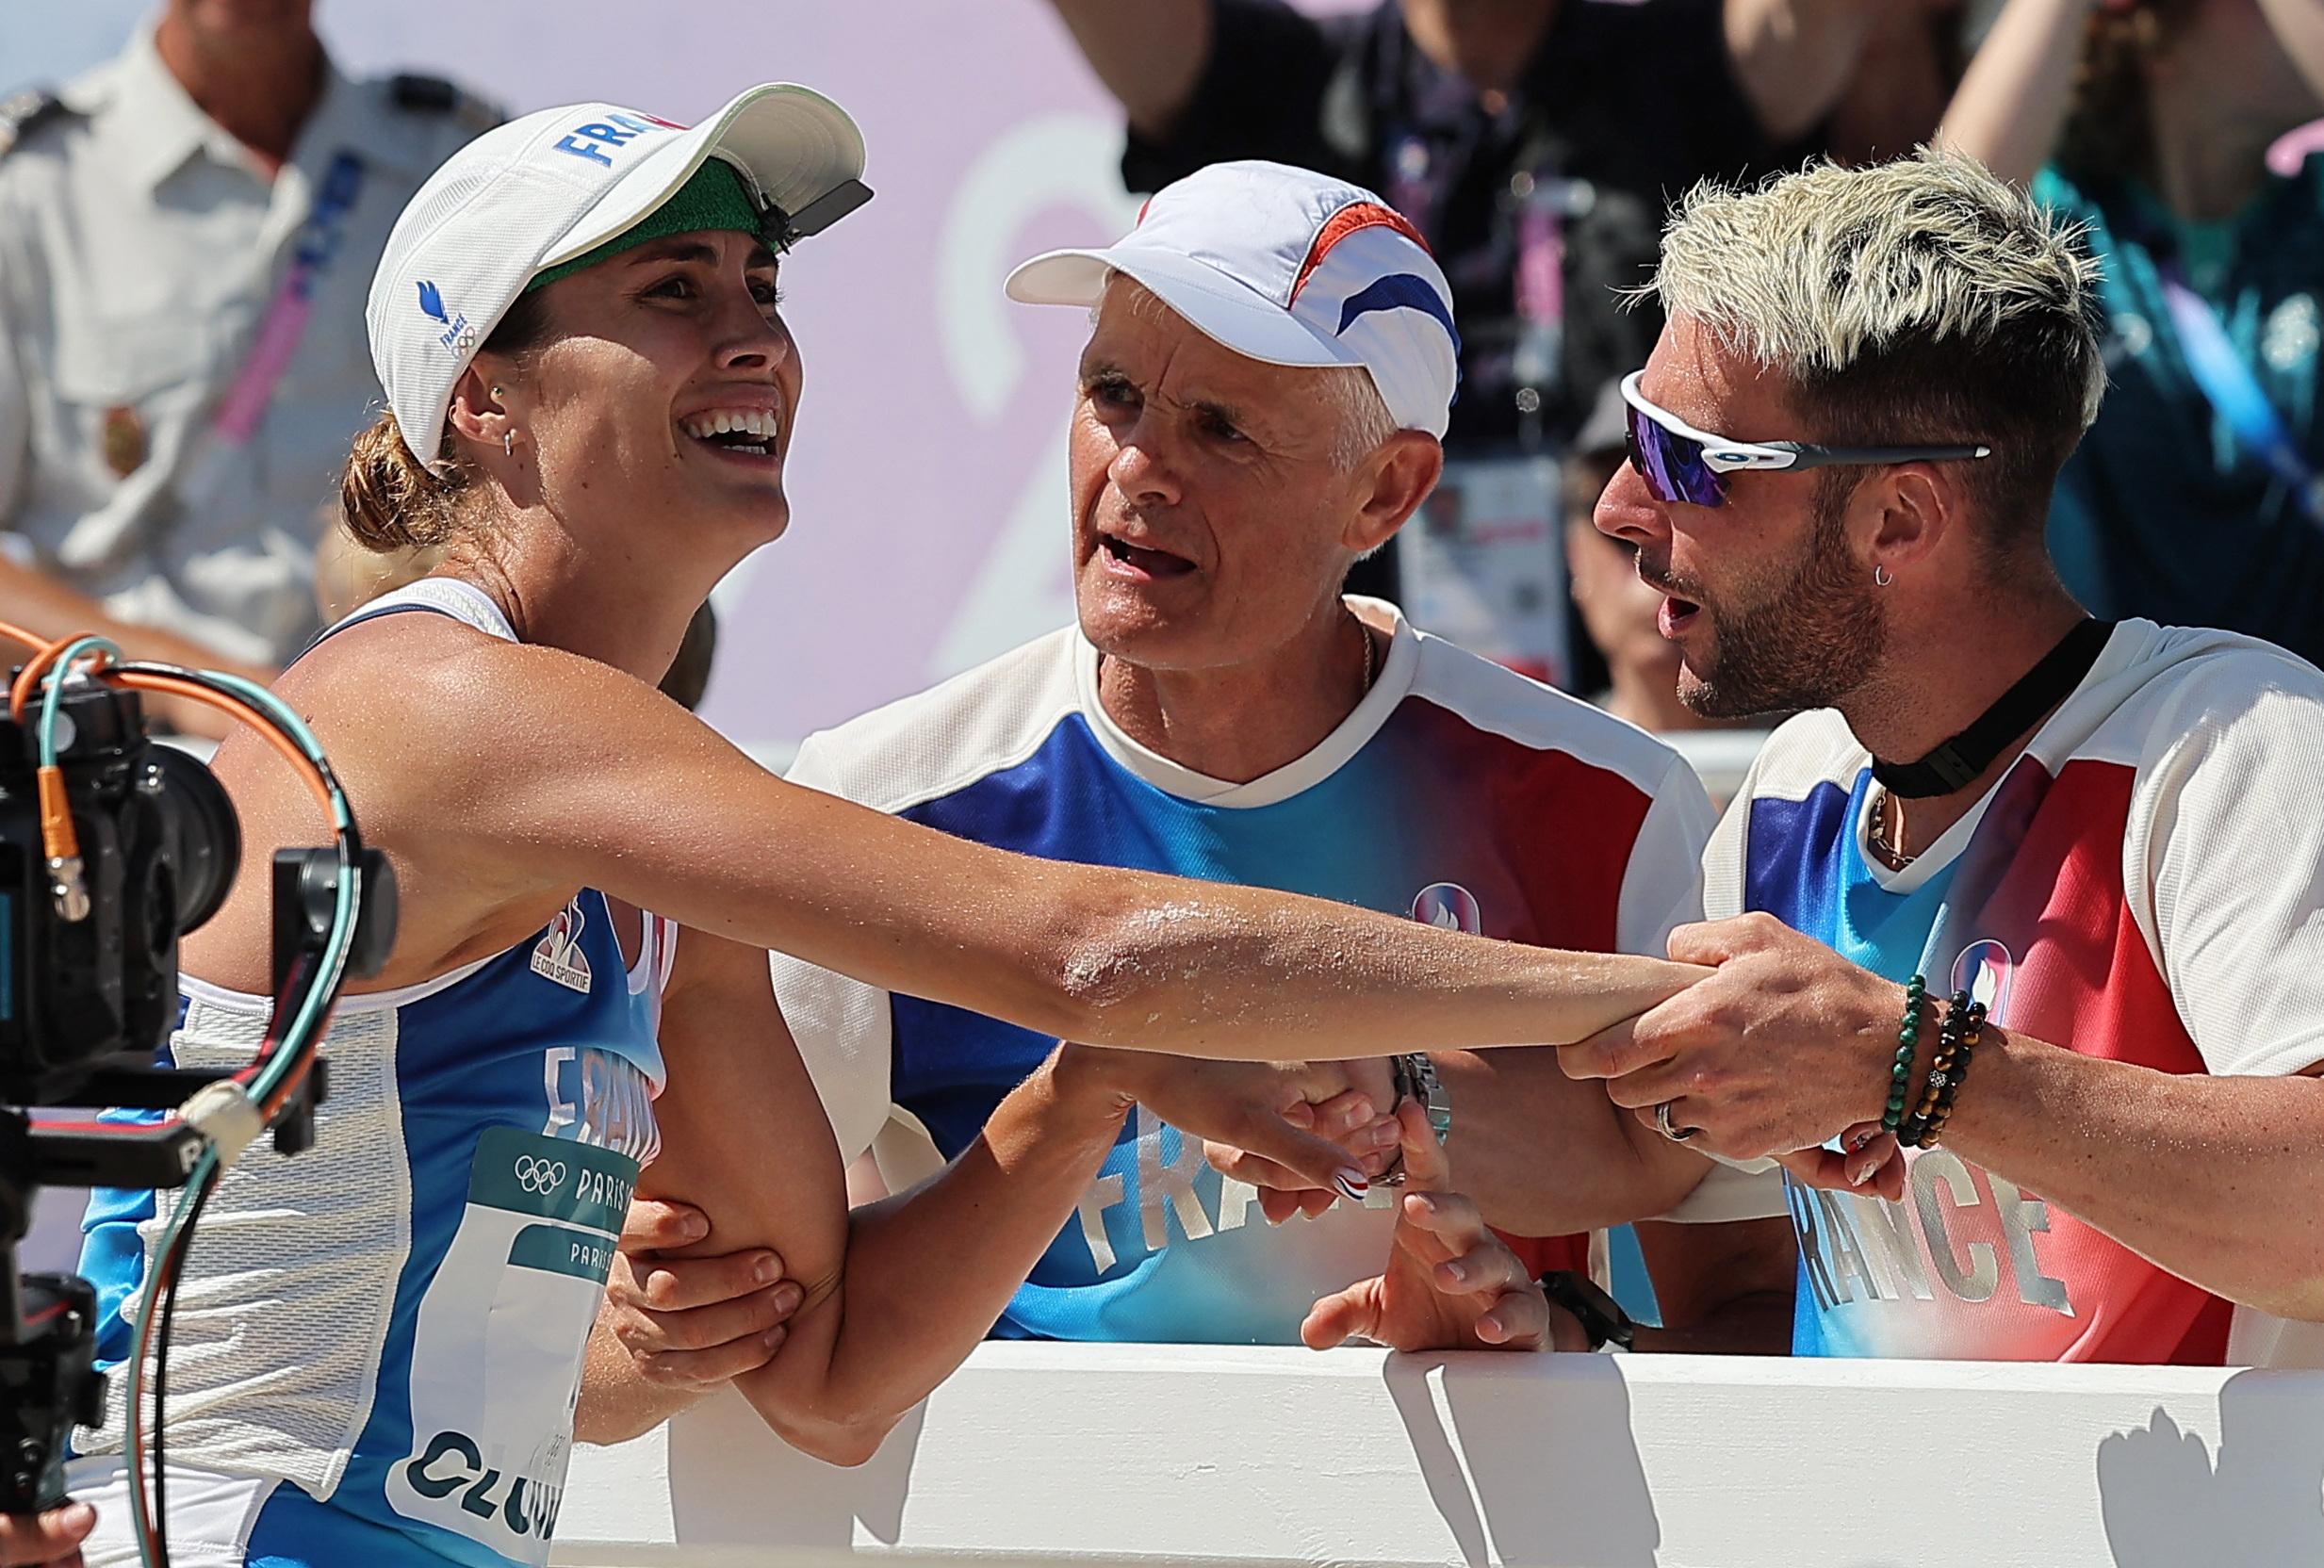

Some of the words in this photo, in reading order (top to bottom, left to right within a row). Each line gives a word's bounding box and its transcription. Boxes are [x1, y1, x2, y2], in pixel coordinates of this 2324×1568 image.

[439, 312, 468, 352] FRANCE
[532, 954, 541, 971] LE
[541, 958, 555, 978] COQ
[555, 965, 589, 989] SPORTIF
